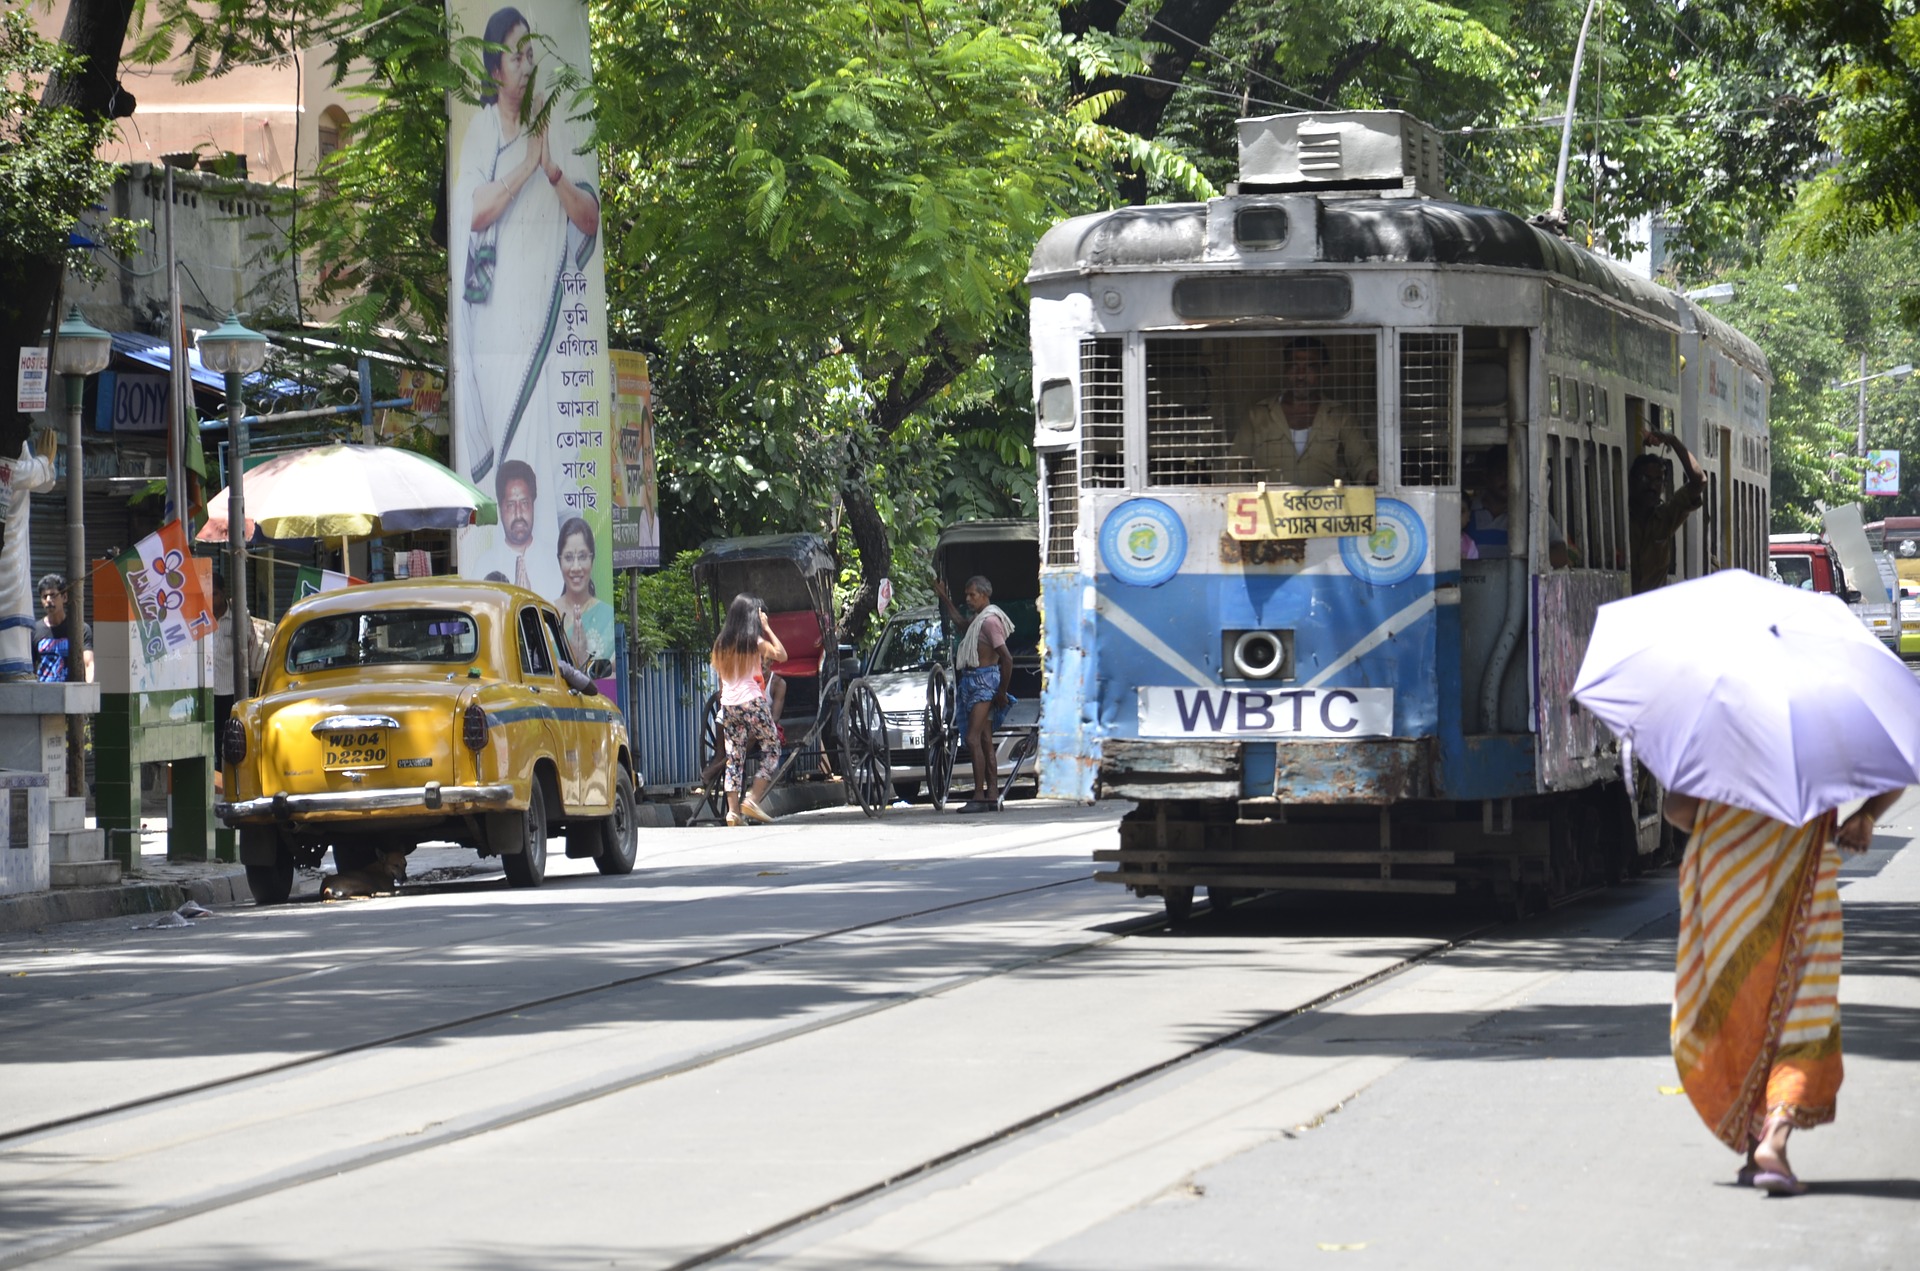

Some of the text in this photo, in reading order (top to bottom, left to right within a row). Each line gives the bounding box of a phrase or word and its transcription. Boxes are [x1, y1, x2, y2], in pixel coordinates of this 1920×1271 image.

[561, 272, 588, 296] দিদি
[562, 302, 588, 331] তুমি
[556, 333, 599, 357] এগিয়ে
[20, 357, 48, 370] HOSTEL
[560, 369, 594, 388] চলো
[115, 381, 169, 425] BONY
[557, 399, 600, 418] আমরা
[556, 429, 603, 450] তোমার
[562, 460, 597, 480] সাথে
[564, 486, 599, 511] আছি
[1282, 490, 1345, 512] ধর্মতলা
[1234, 498, 1258, 535] 5
[1174, 689, 1359, 733] WBTC
